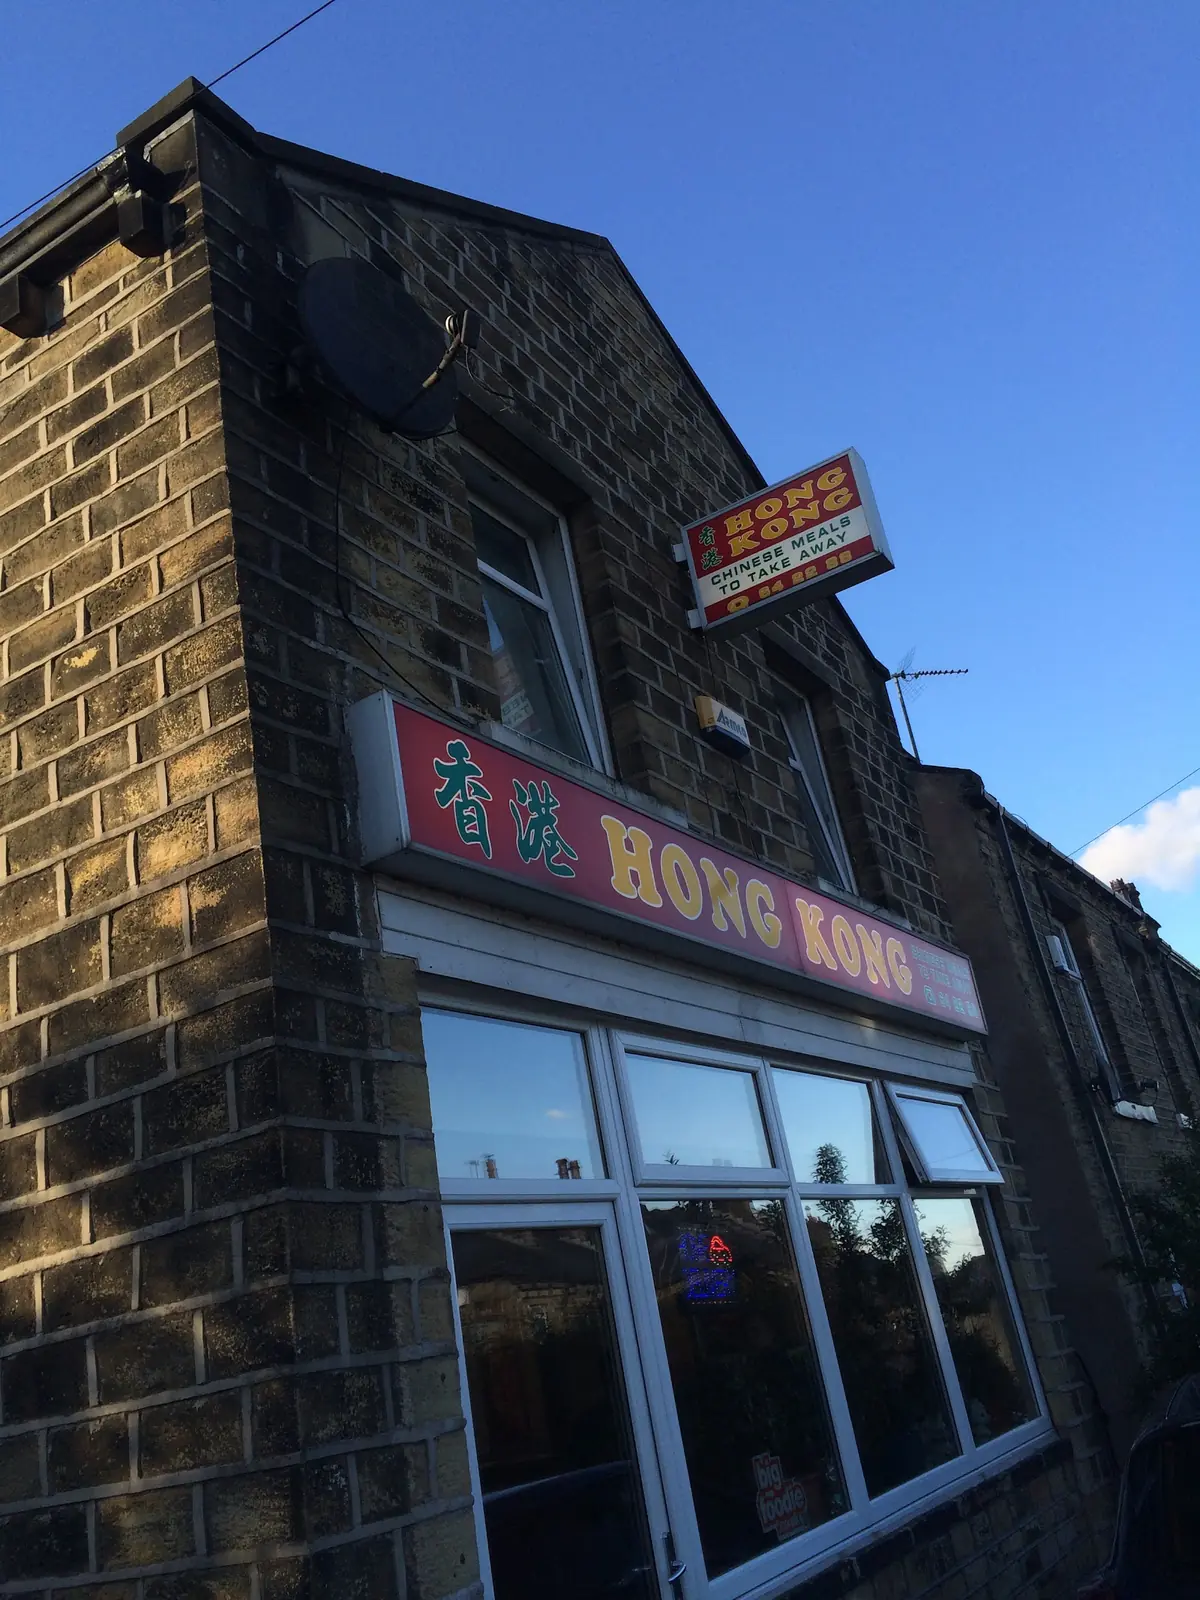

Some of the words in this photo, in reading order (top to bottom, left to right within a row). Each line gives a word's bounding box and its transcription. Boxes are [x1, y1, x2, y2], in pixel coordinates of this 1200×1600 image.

[723, 466, 847, 537] HONG
[727, 487, 854, 557] KONG
[698, 526, 723, 570] 香港
[711, 546, 784, 586] CHINESE
[791, 516, 851, 552] MEALS
[719, 580, 741, 595] TO
[748, 557, 791, 584] TAKE
[800, 532, 847, 561] AWAY
[433, 739, 578, 878] 香港
[600, 814, 782, 949] HONG
[795, 897, 913, 996] KONG
[756, 1459, 782, 1490] big
[758, 1484, 805, 1524] foodie
